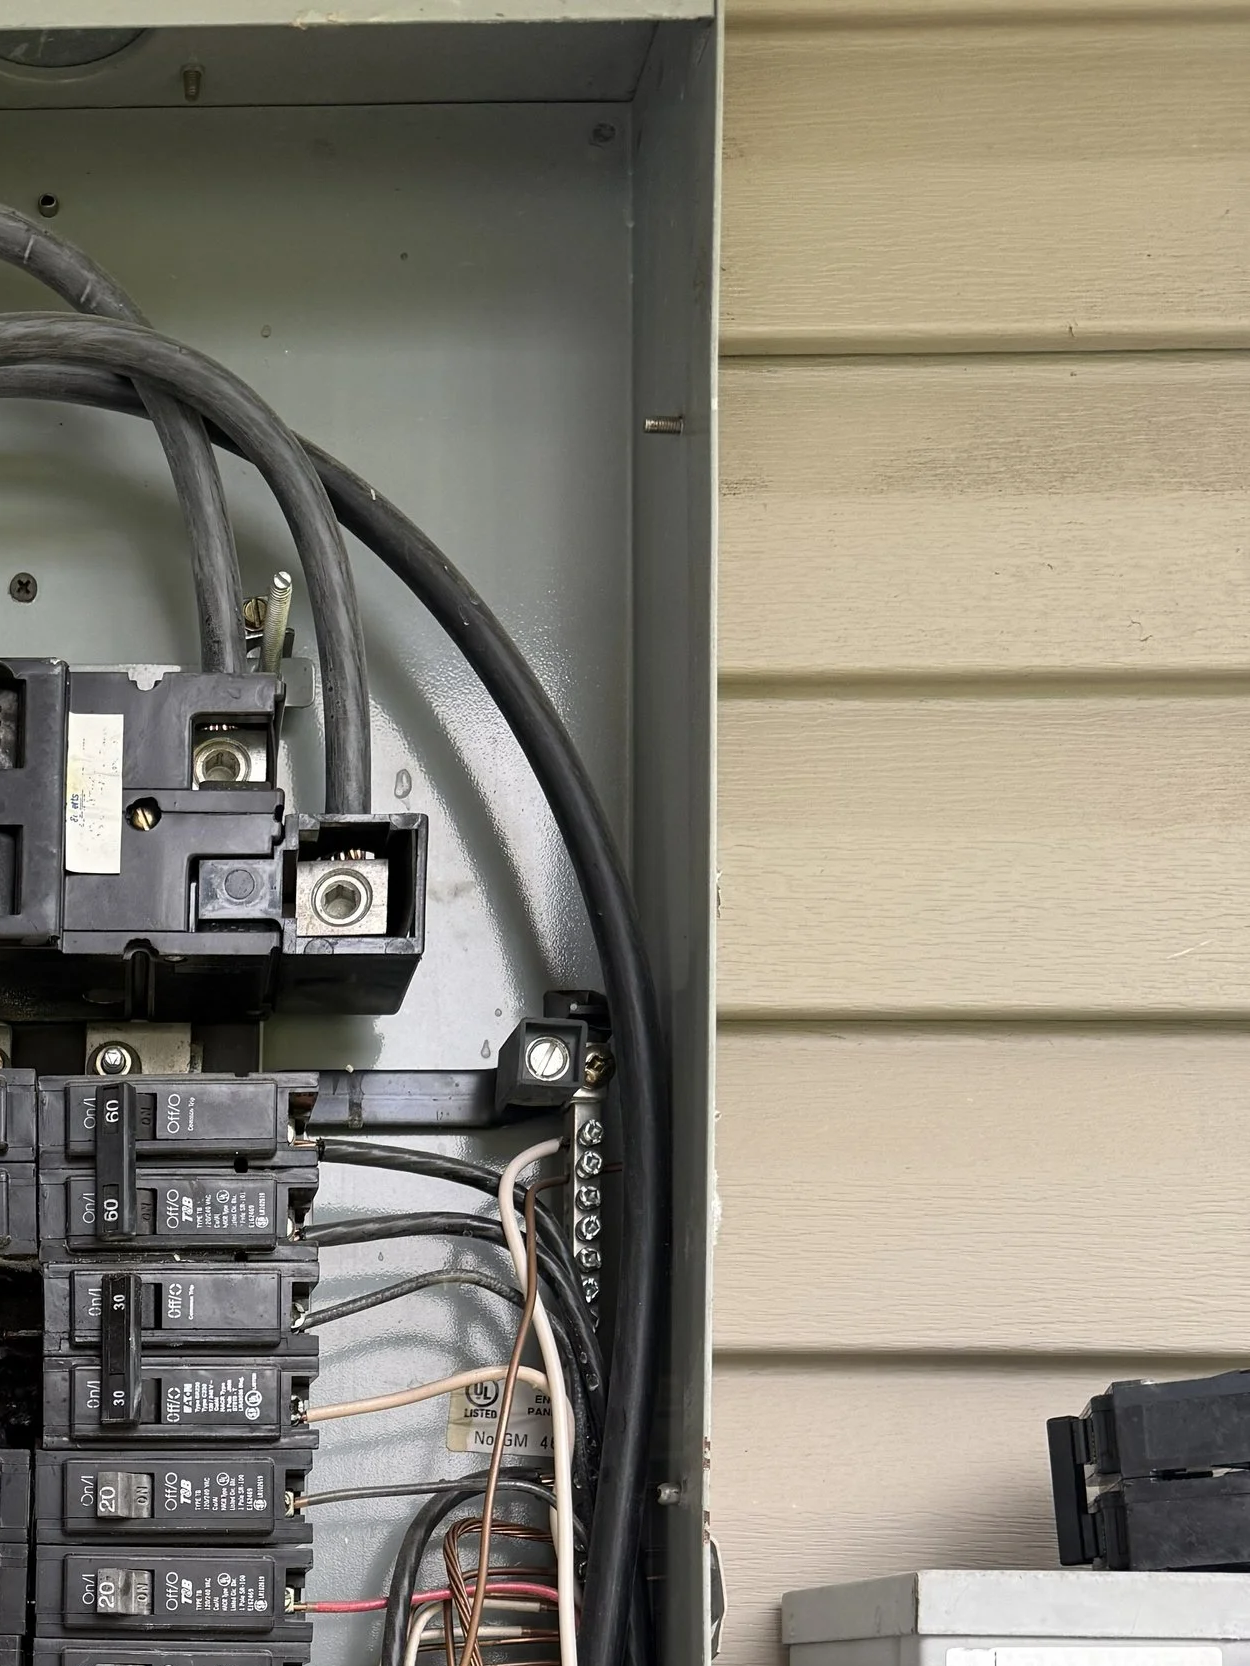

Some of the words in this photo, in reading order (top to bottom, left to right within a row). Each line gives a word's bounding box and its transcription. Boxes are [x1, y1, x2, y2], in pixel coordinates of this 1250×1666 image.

[106, 1100, 118, 1122] 60
[104, 1199, 118, 1221] 60
[114, 1295, 125, 1310] 30
[113, 1391, 124, 1405] 30
[473, 1381, 491, 1399] UL
[464, 1408, 497, 1418] LISTED
[100, 1486, 115, 1512] 20
[100, 1582, 115, 1608] 20
